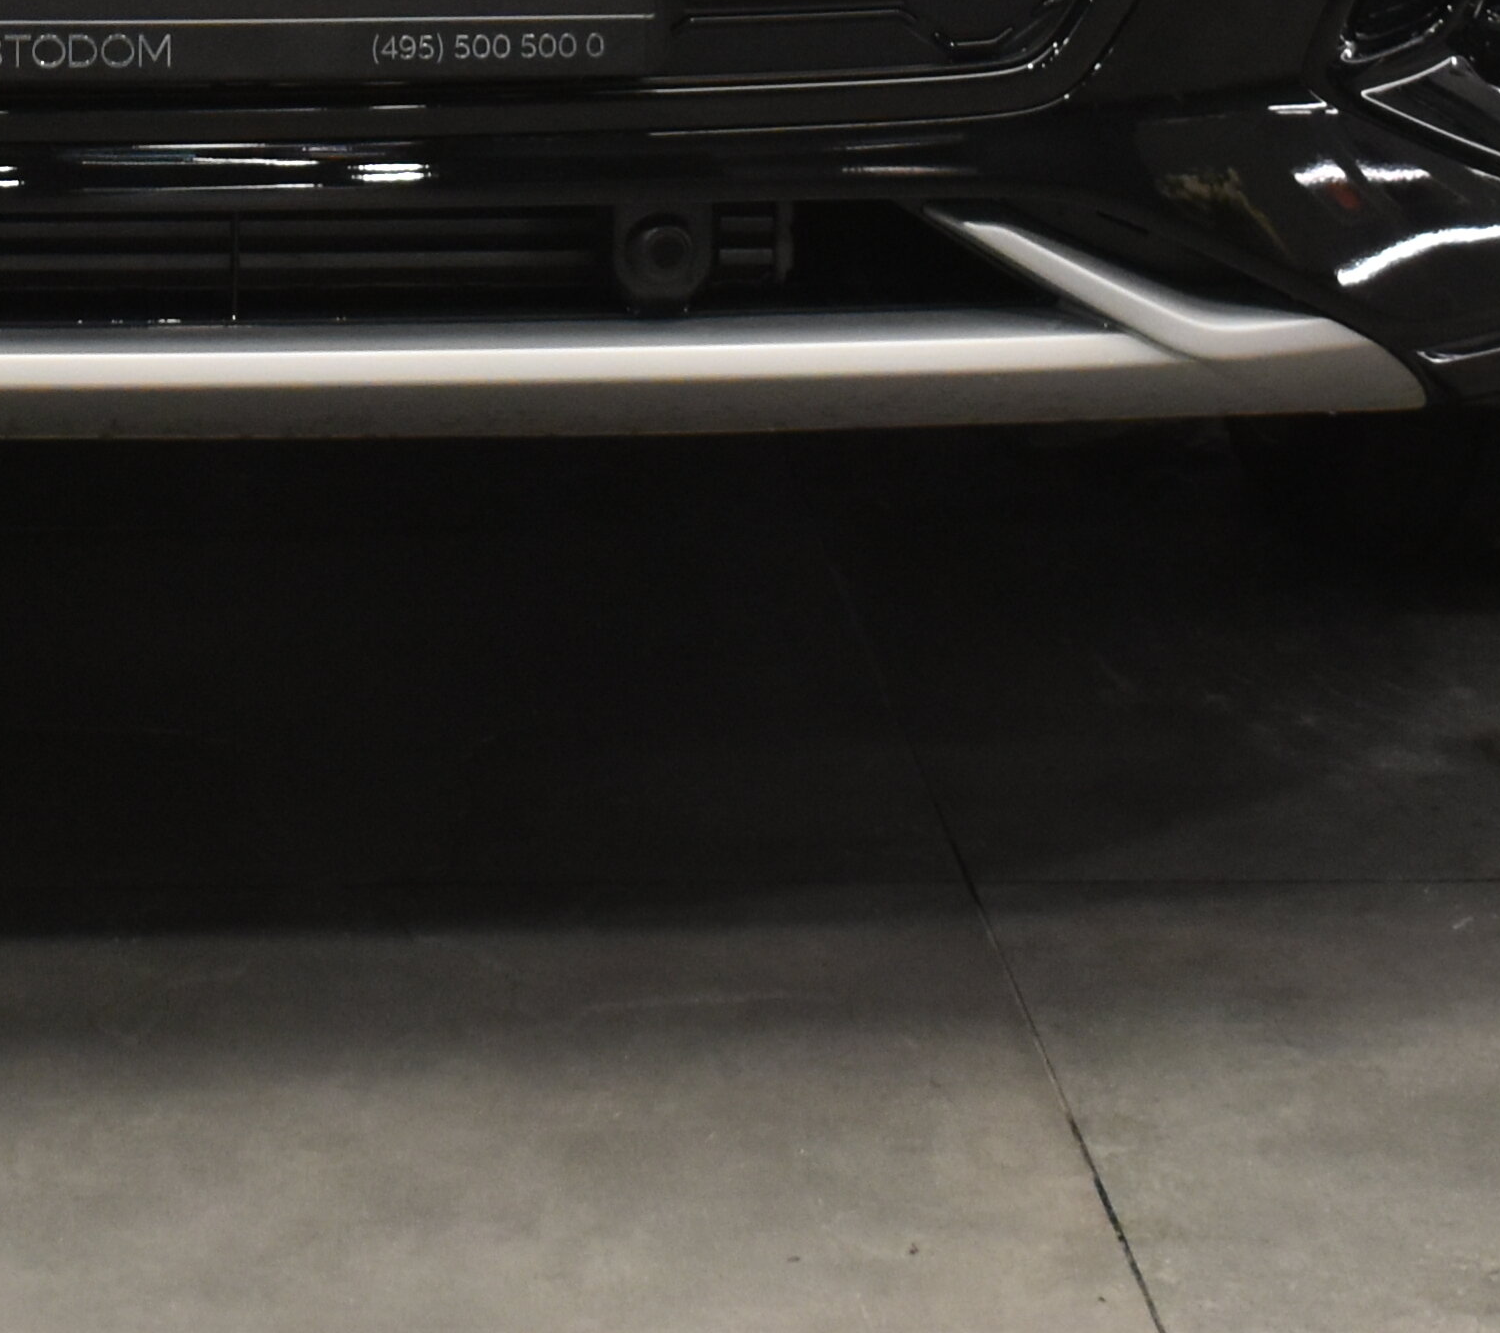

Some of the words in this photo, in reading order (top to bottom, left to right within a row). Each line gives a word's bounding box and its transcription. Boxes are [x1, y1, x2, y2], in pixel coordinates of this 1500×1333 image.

[372, 32, 444, 65] (495)
[454, 33, 512, 60] 500
[520, 32, 578, 59] 500
[585, 32, 605, 58] 0
